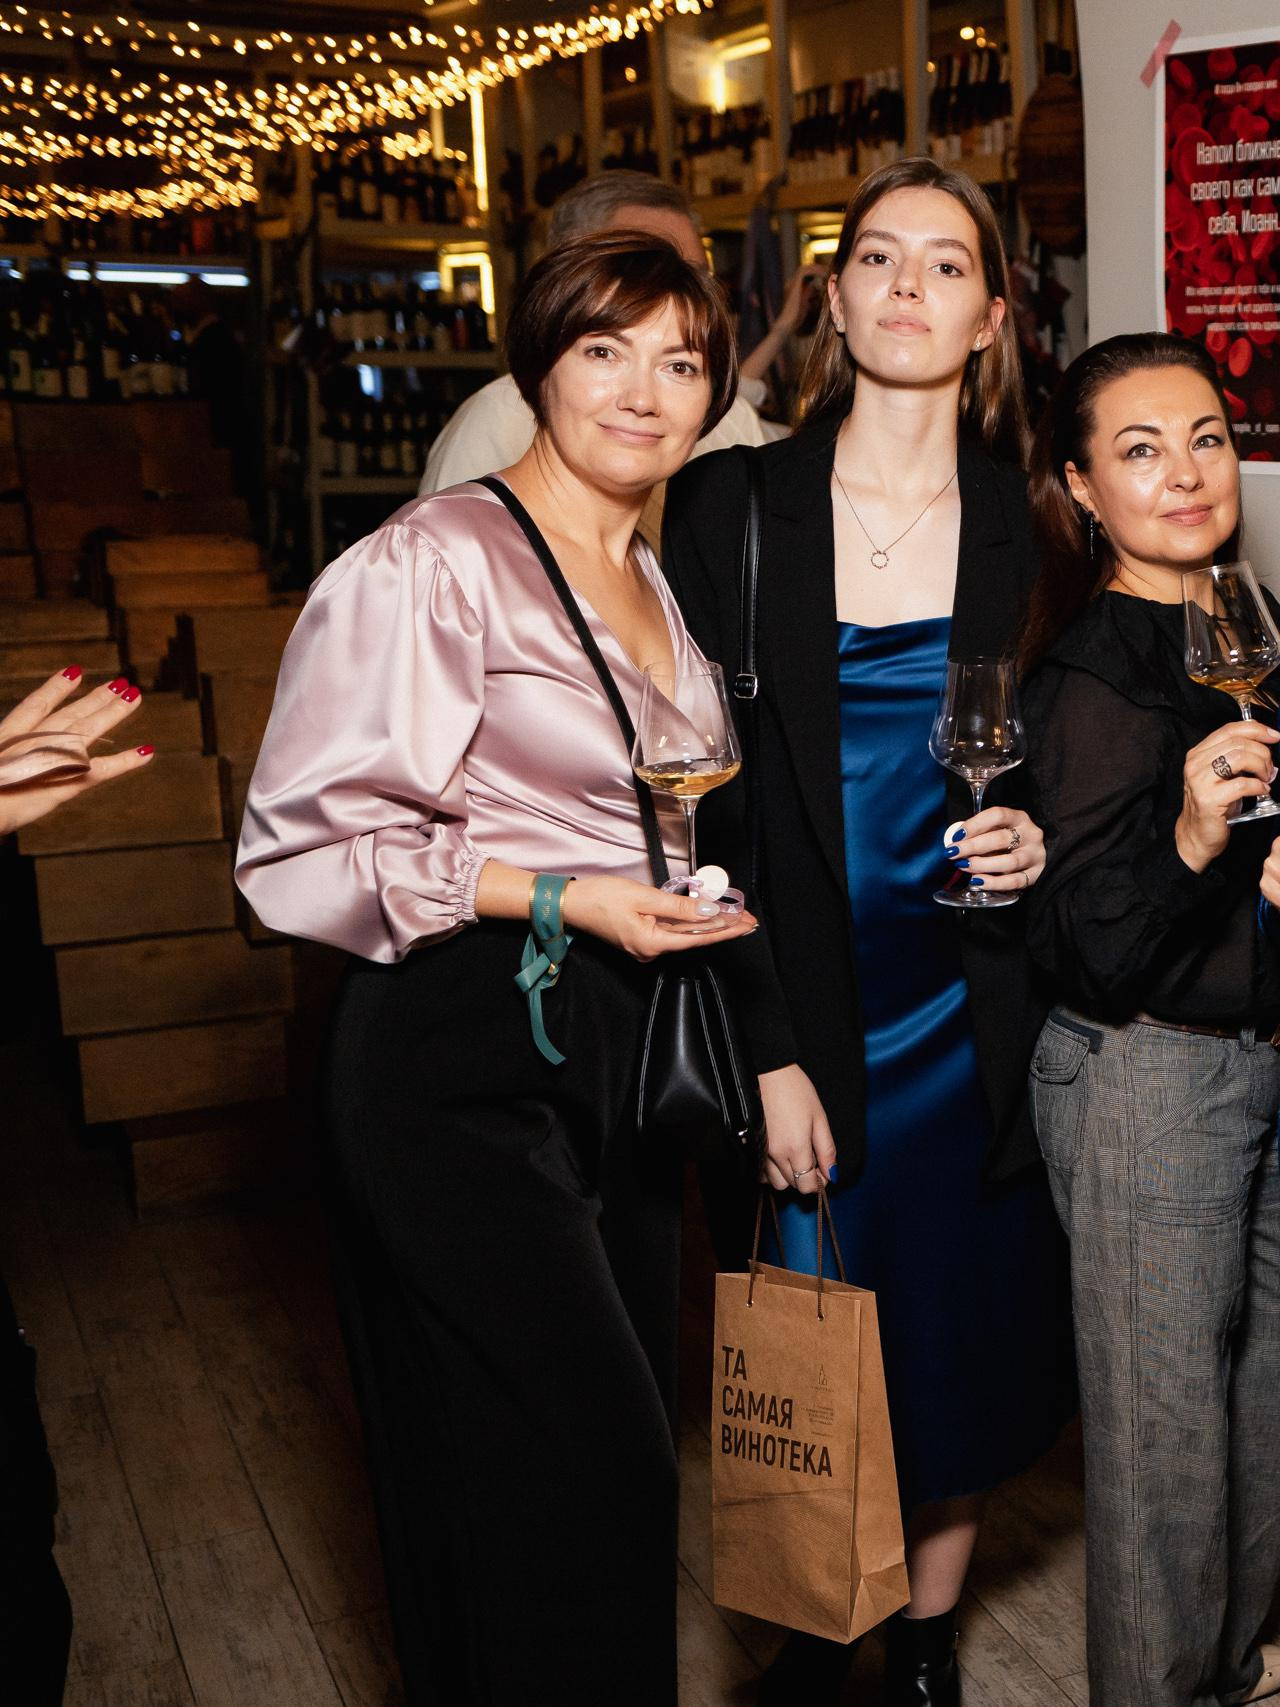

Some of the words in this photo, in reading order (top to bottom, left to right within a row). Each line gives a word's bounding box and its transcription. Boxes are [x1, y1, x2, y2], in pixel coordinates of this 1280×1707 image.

[1196, 142, 1233, 165] Напои
[1190, 180, 1230, 201] своего
[1233, 178, 1254, 198] как
[1208, 211, 1239, 236] себя,
[1242, 209, 1280, 233] Иоанн.
[722, 1345, 748, 1381] ТА
[721, 1385, 793, 1430] САМАЯ
[721, 1423, 833, 1478] ВИНОТЕКА
